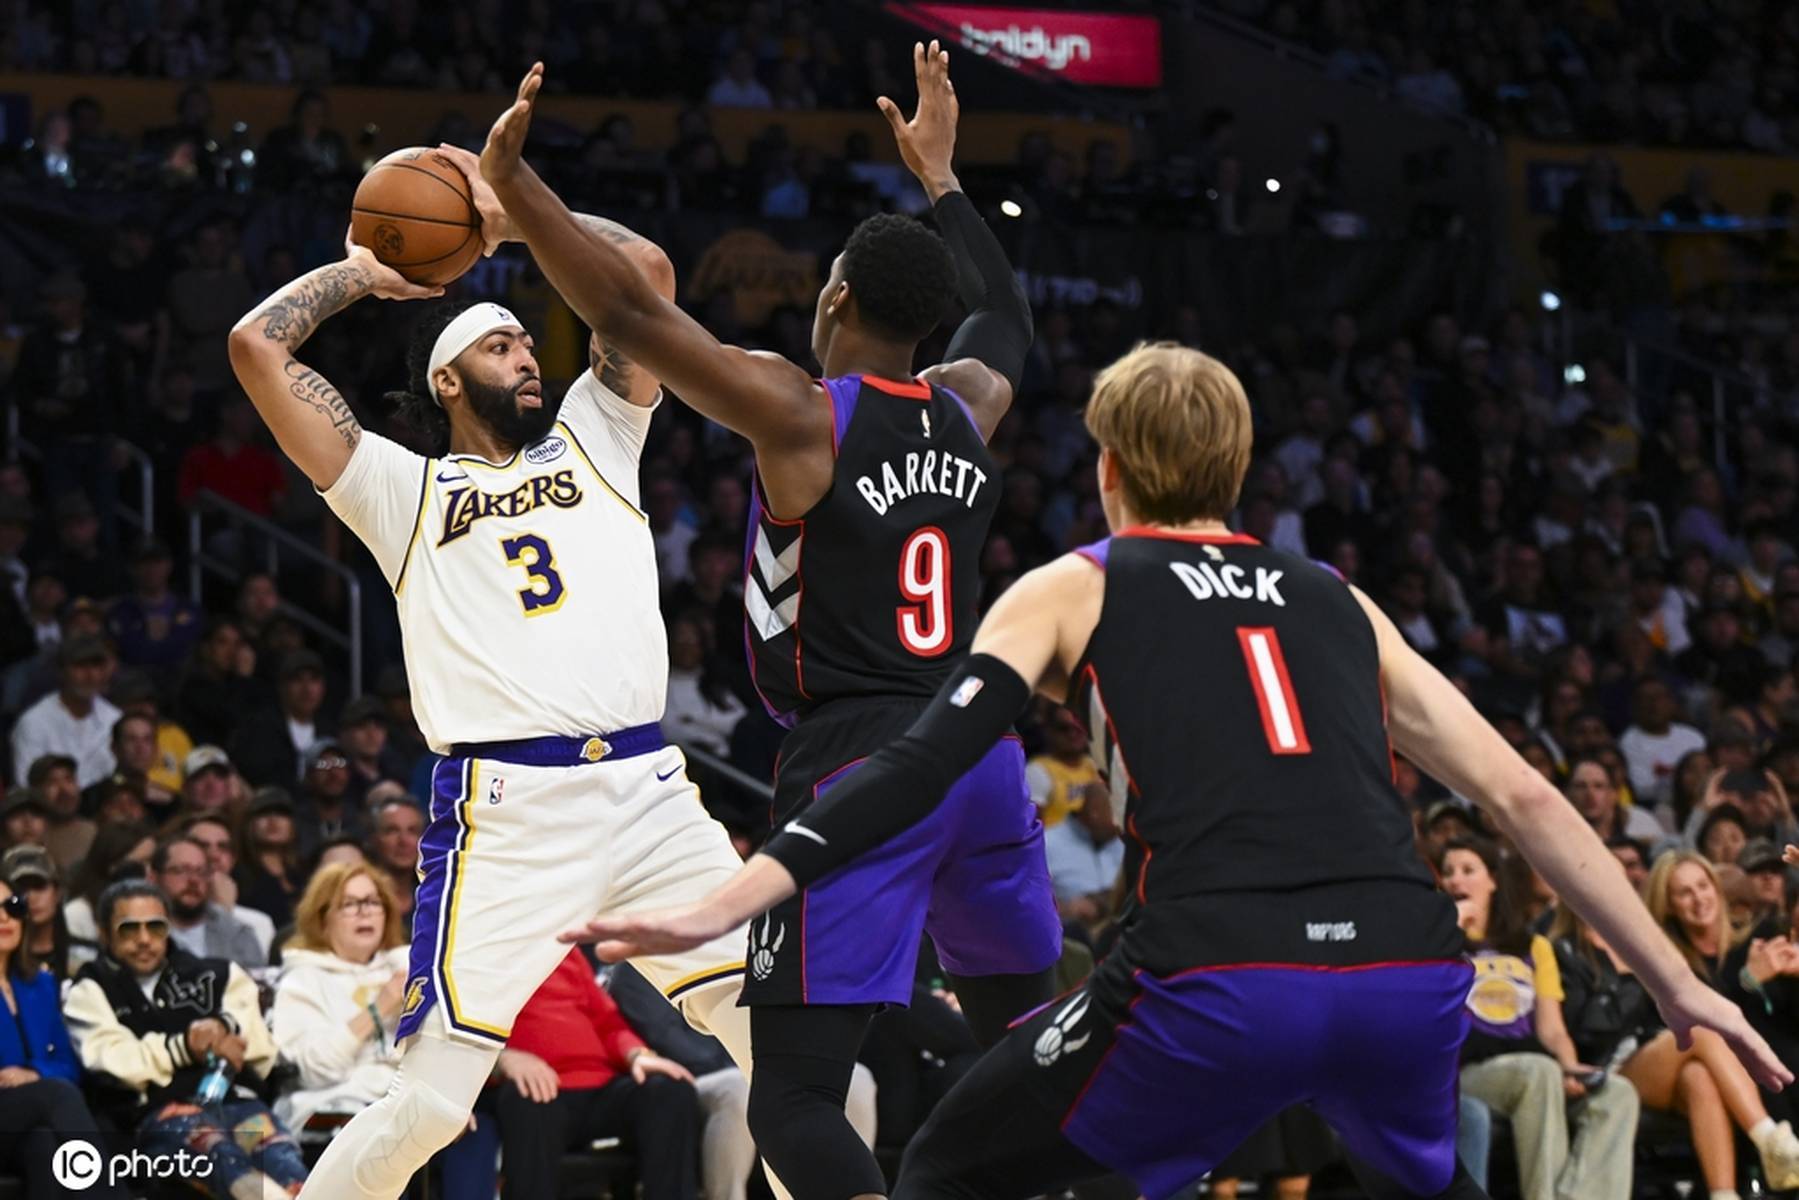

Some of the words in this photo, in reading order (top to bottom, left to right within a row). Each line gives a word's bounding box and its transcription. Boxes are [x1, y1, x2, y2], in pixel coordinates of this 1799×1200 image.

[436, 469, 583, 549] LAKERS
[856, 449, 987, 517] BARRETT
[500, 533, 568, 619] 3
[896, 526, 954, 658] 9
[1169, 561, 1286, 607] DICK
[1235, 625, 1312, 755] 1
